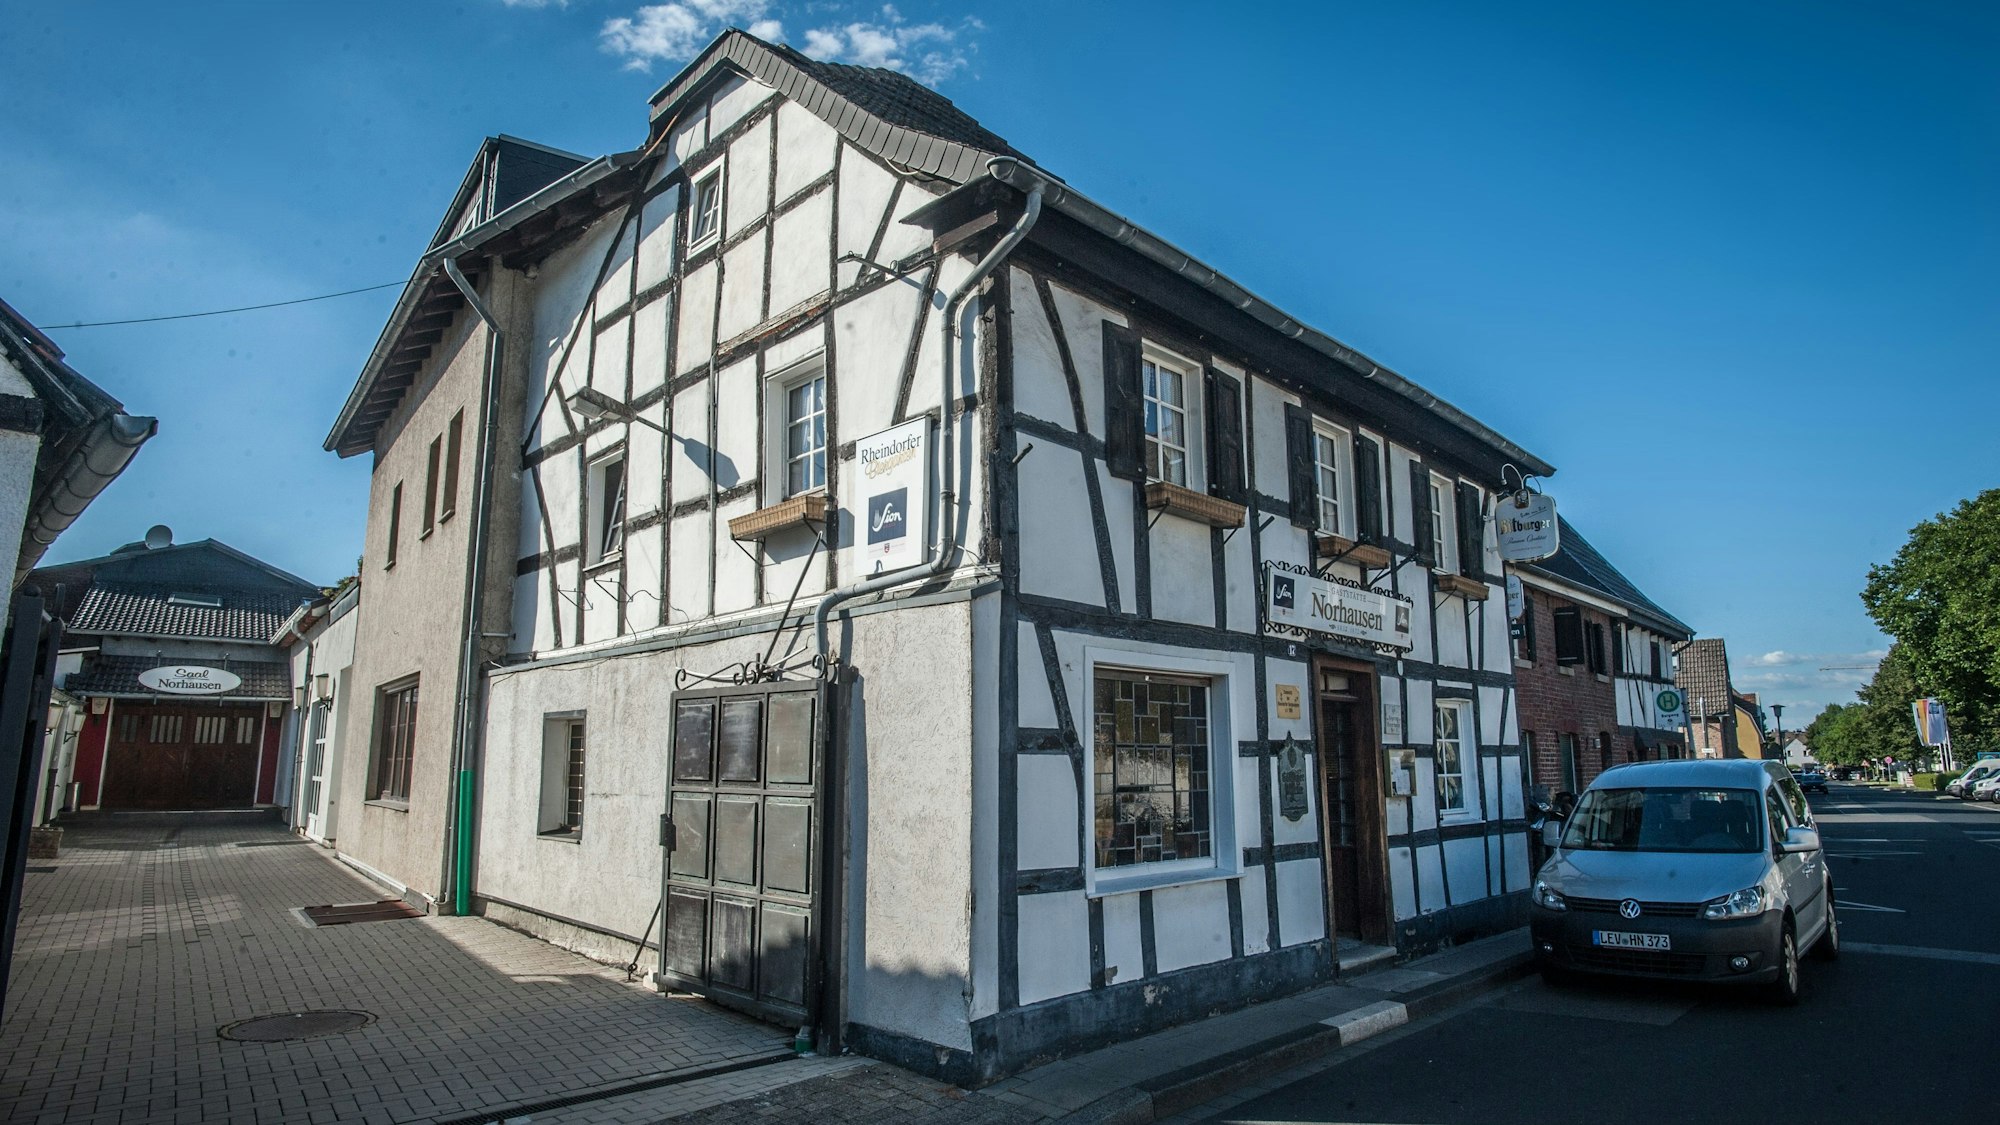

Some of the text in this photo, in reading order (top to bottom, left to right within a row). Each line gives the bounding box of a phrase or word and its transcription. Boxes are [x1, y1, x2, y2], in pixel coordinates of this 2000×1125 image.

[861, 434, 921, 464] Rheindorfer
[872, 503, 902, 532] Sion
[1311, 592, 1383, 631] Norhausen
[174, 668, 209, 678] Saal
[158, 679, 221, 690] Norhausen
[1600, 932, 1669, 948] LEV HN 373
